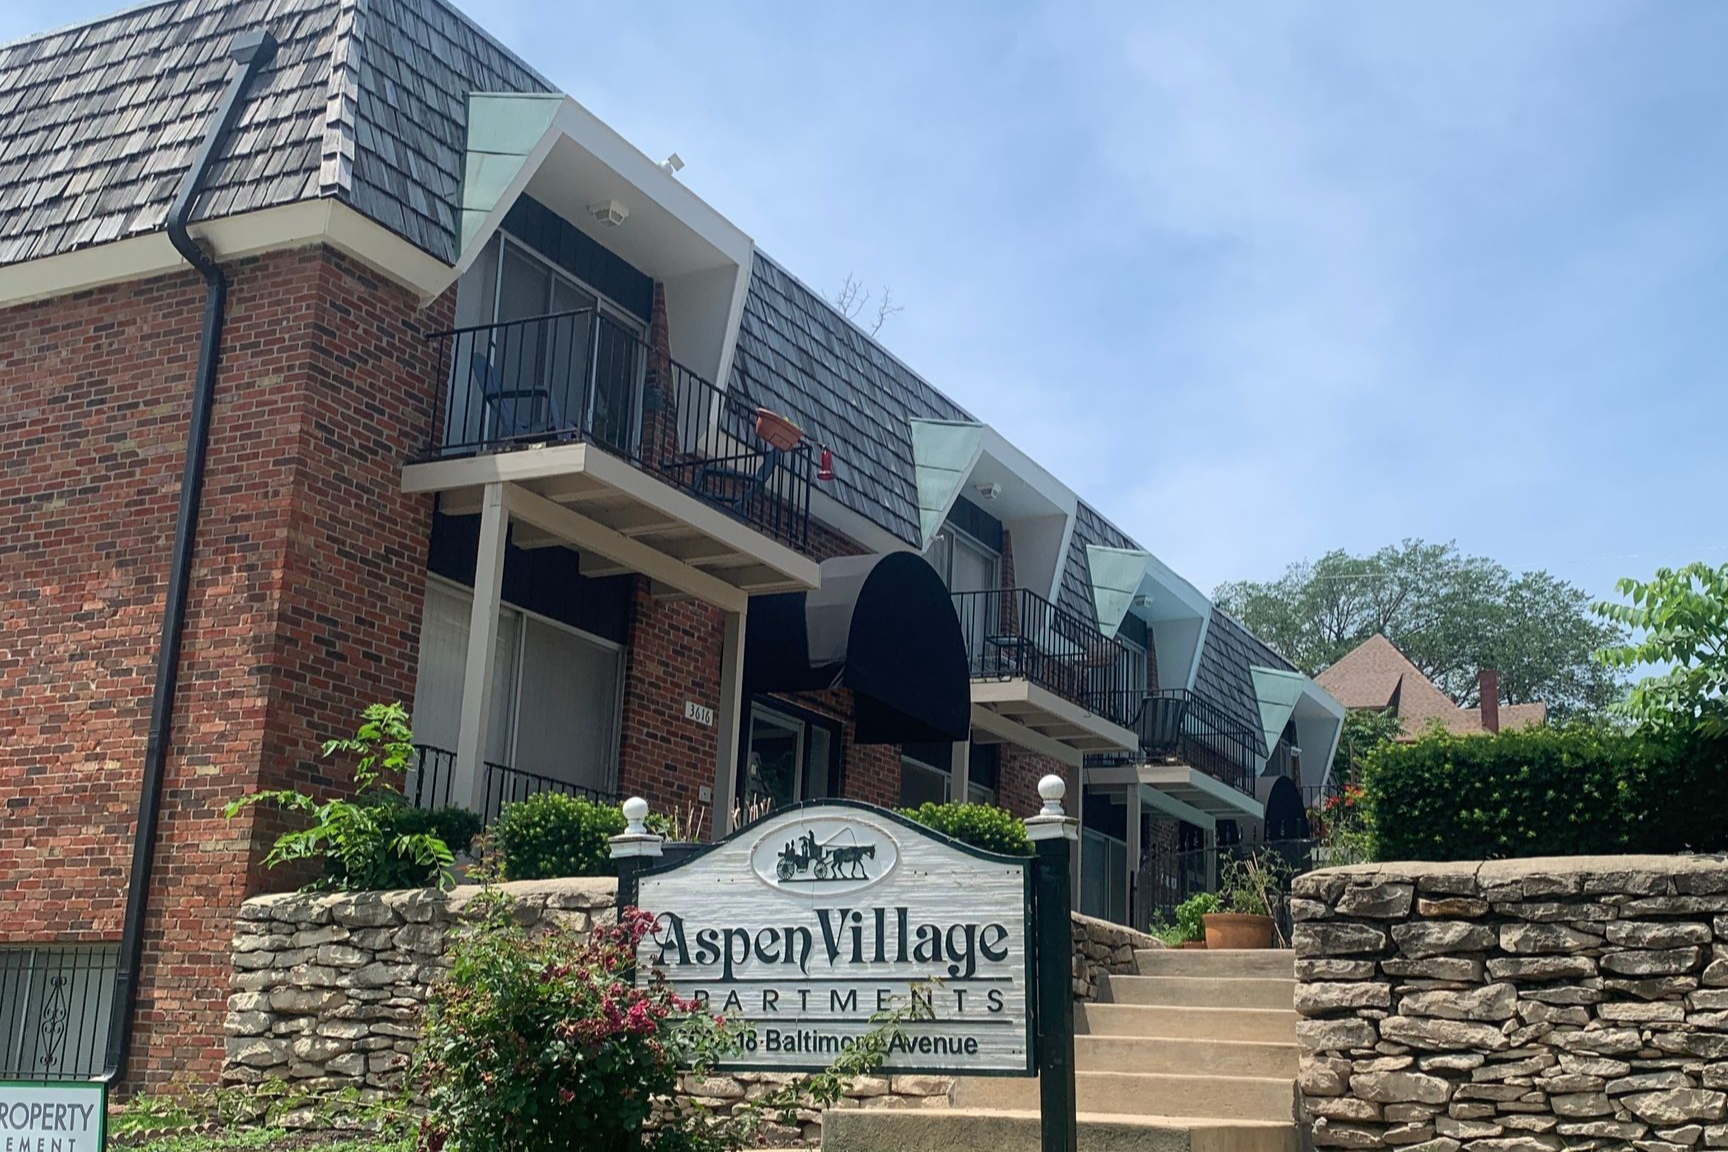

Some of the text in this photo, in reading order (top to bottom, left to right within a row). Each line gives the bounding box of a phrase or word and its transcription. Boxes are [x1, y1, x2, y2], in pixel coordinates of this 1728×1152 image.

[689, 704, 711, 724] 3616
[655, 988, 1004, 1013] PARTMENTS
[887, 1030, 978, 1054] Avenue
